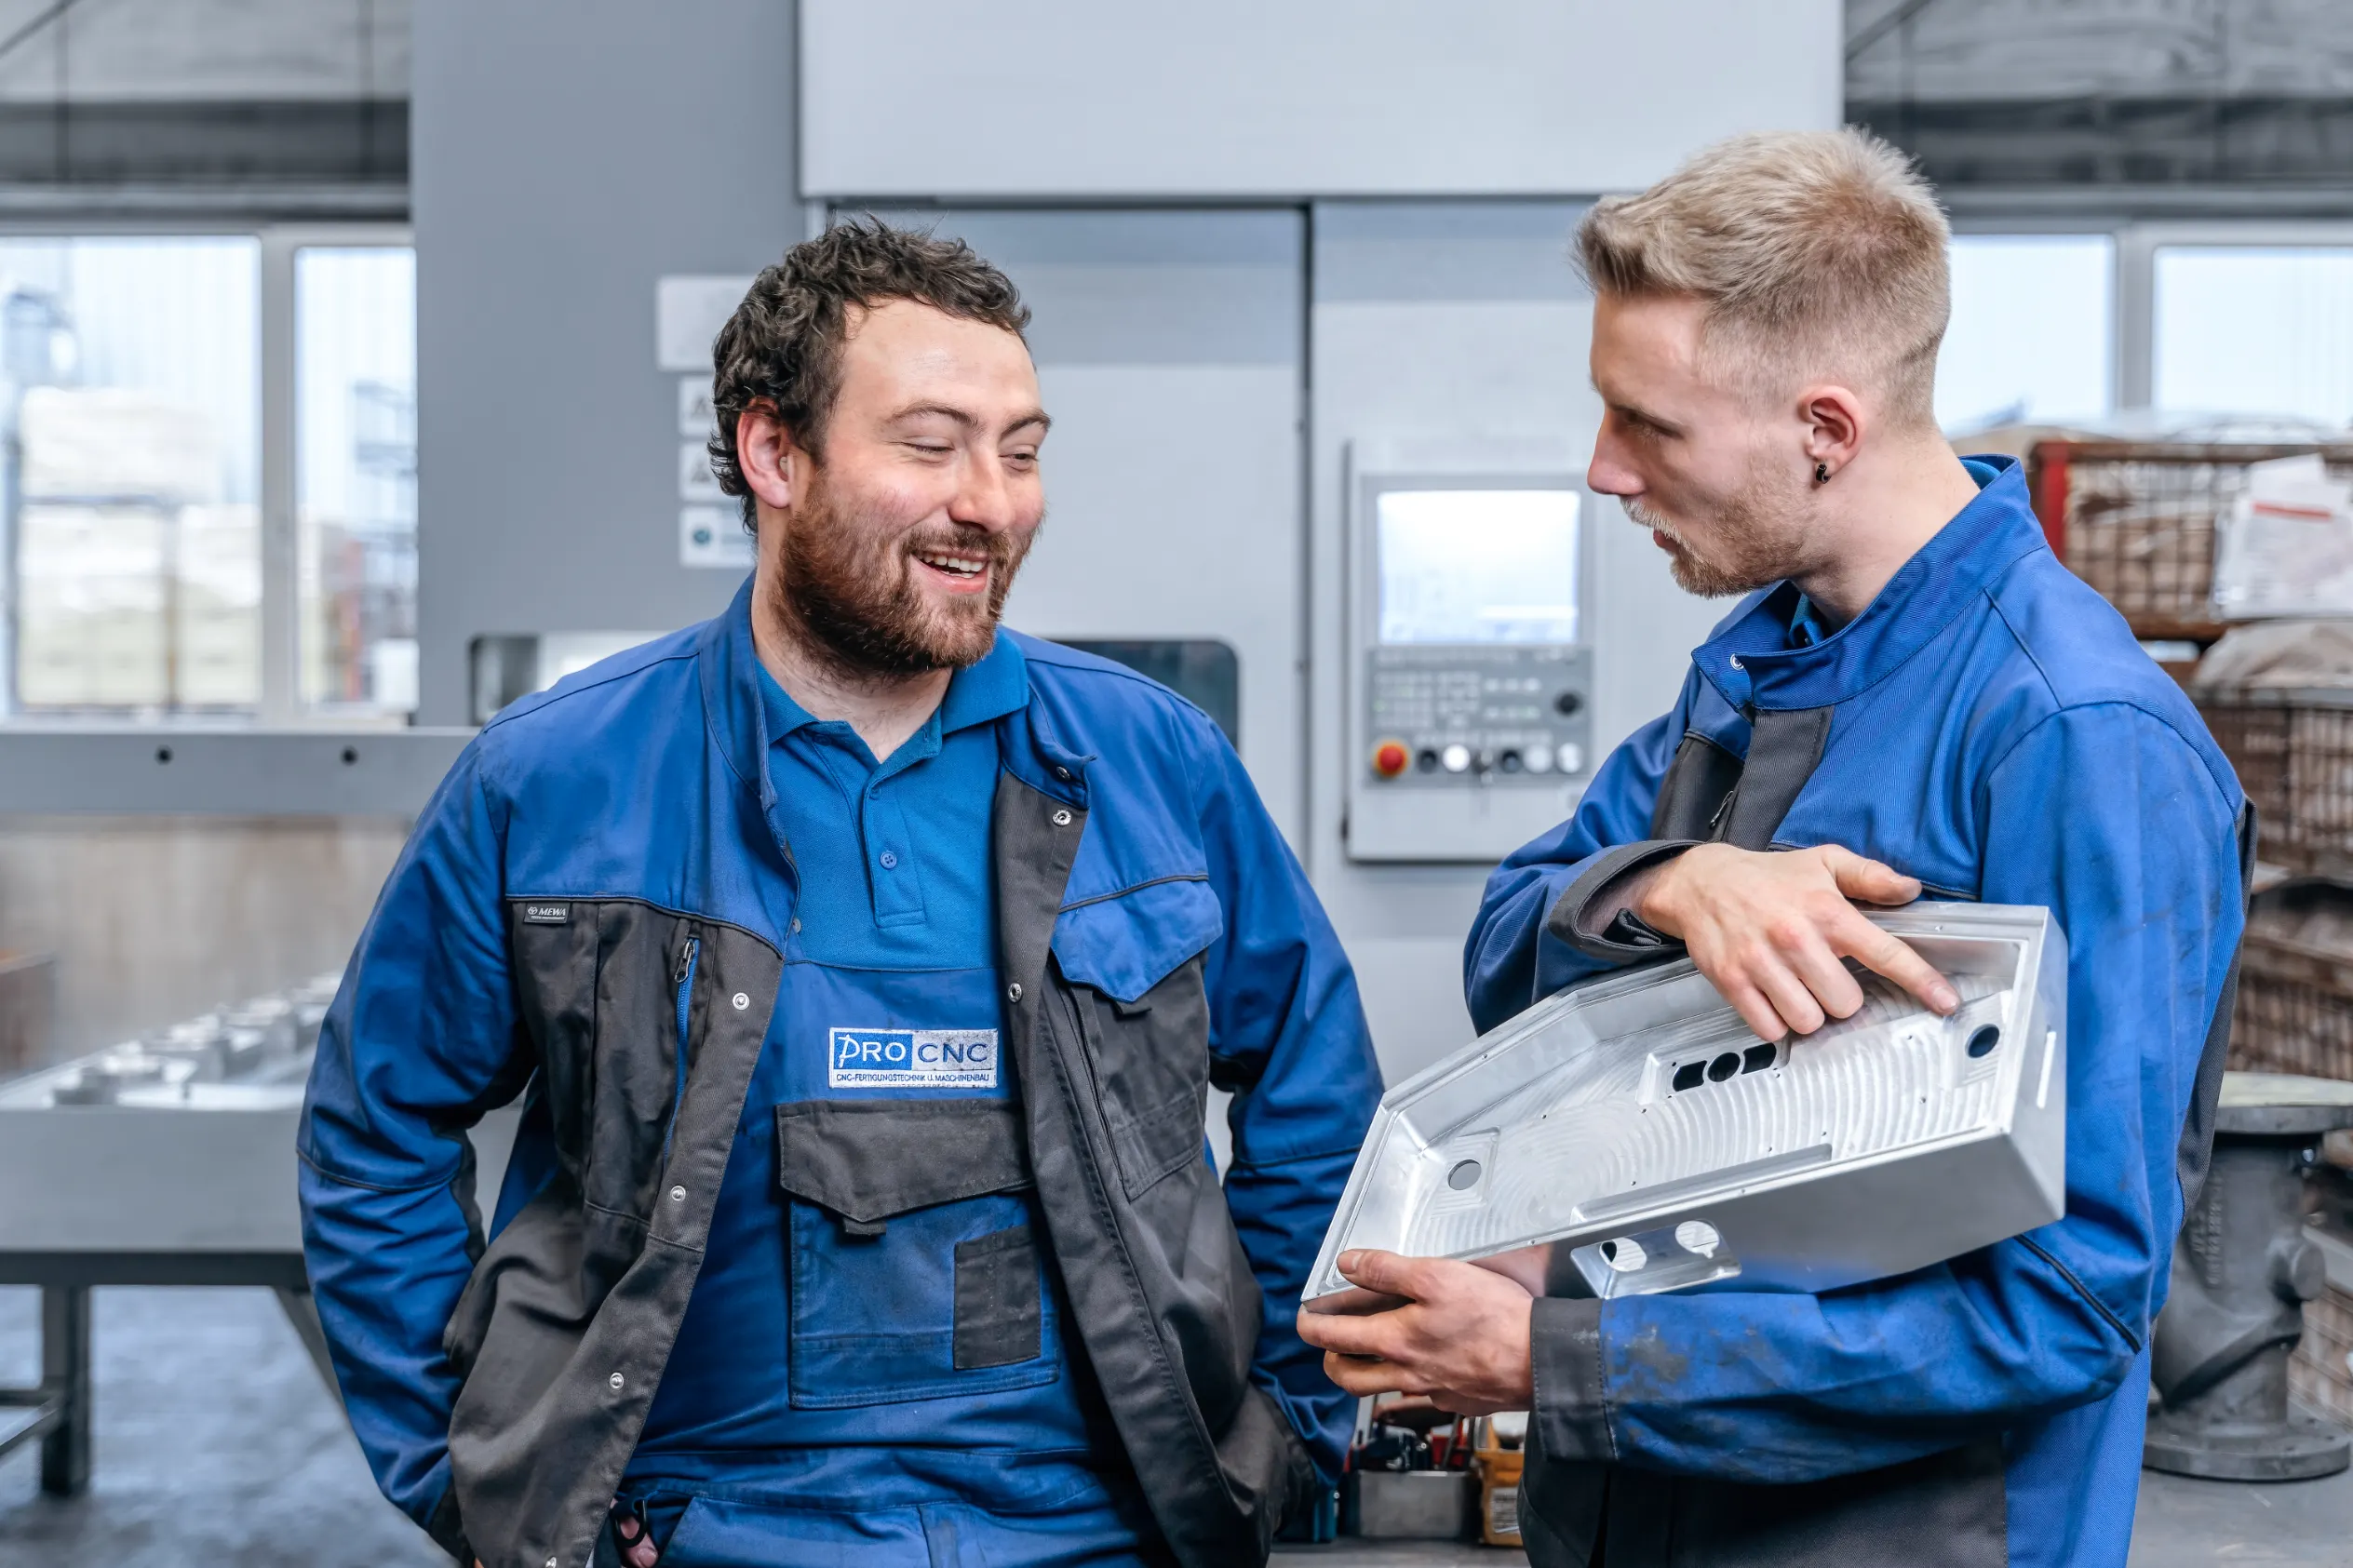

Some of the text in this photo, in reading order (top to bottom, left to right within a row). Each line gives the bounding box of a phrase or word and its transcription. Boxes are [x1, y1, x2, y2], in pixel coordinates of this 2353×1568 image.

[538, 907, 566, 916] MEWA
[837, 1034, 988, 1068] PRO CNC
[836, 1073, 925, 1082] CNC-FERTIGUNGSTECHNIK
[934, 1073, 989, 1082] MASCHINENBAU
